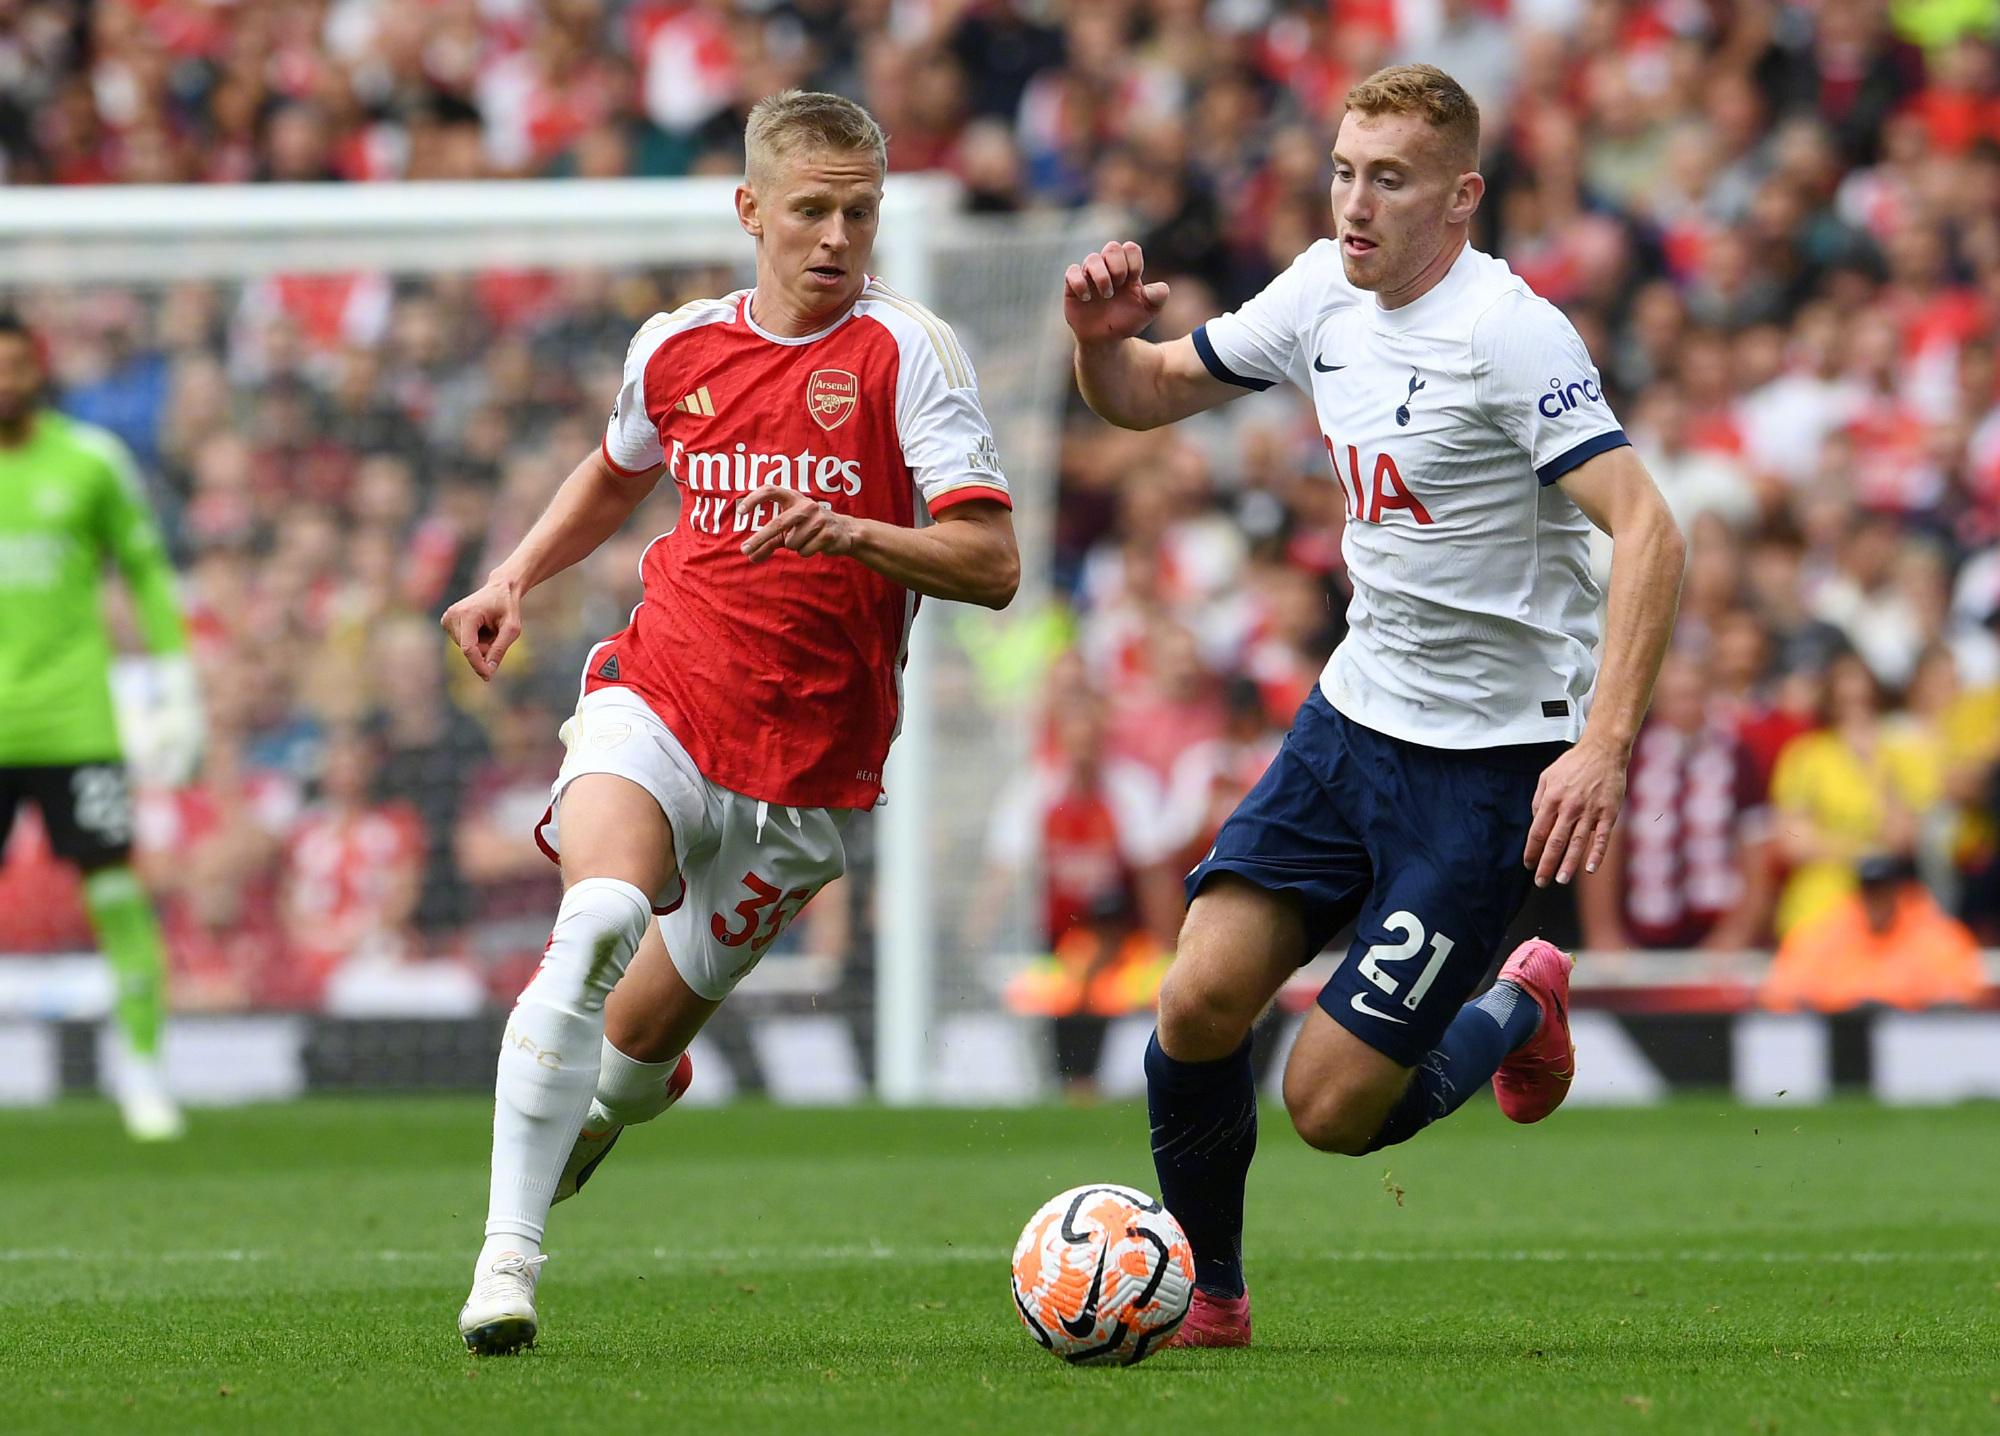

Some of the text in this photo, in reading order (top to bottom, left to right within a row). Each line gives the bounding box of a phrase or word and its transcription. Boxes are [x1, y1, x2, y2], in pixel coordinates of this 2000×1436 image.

[815, 379, 851, 392] Arsenal
[1538, 377, 1603, 418] cinc
[669, 440, 862, 497] Emirates
[711, 870, 811, 952] 35
[1357, 910, 1455, 1011] 21
[504, 1026, 563, 1071] AFC
